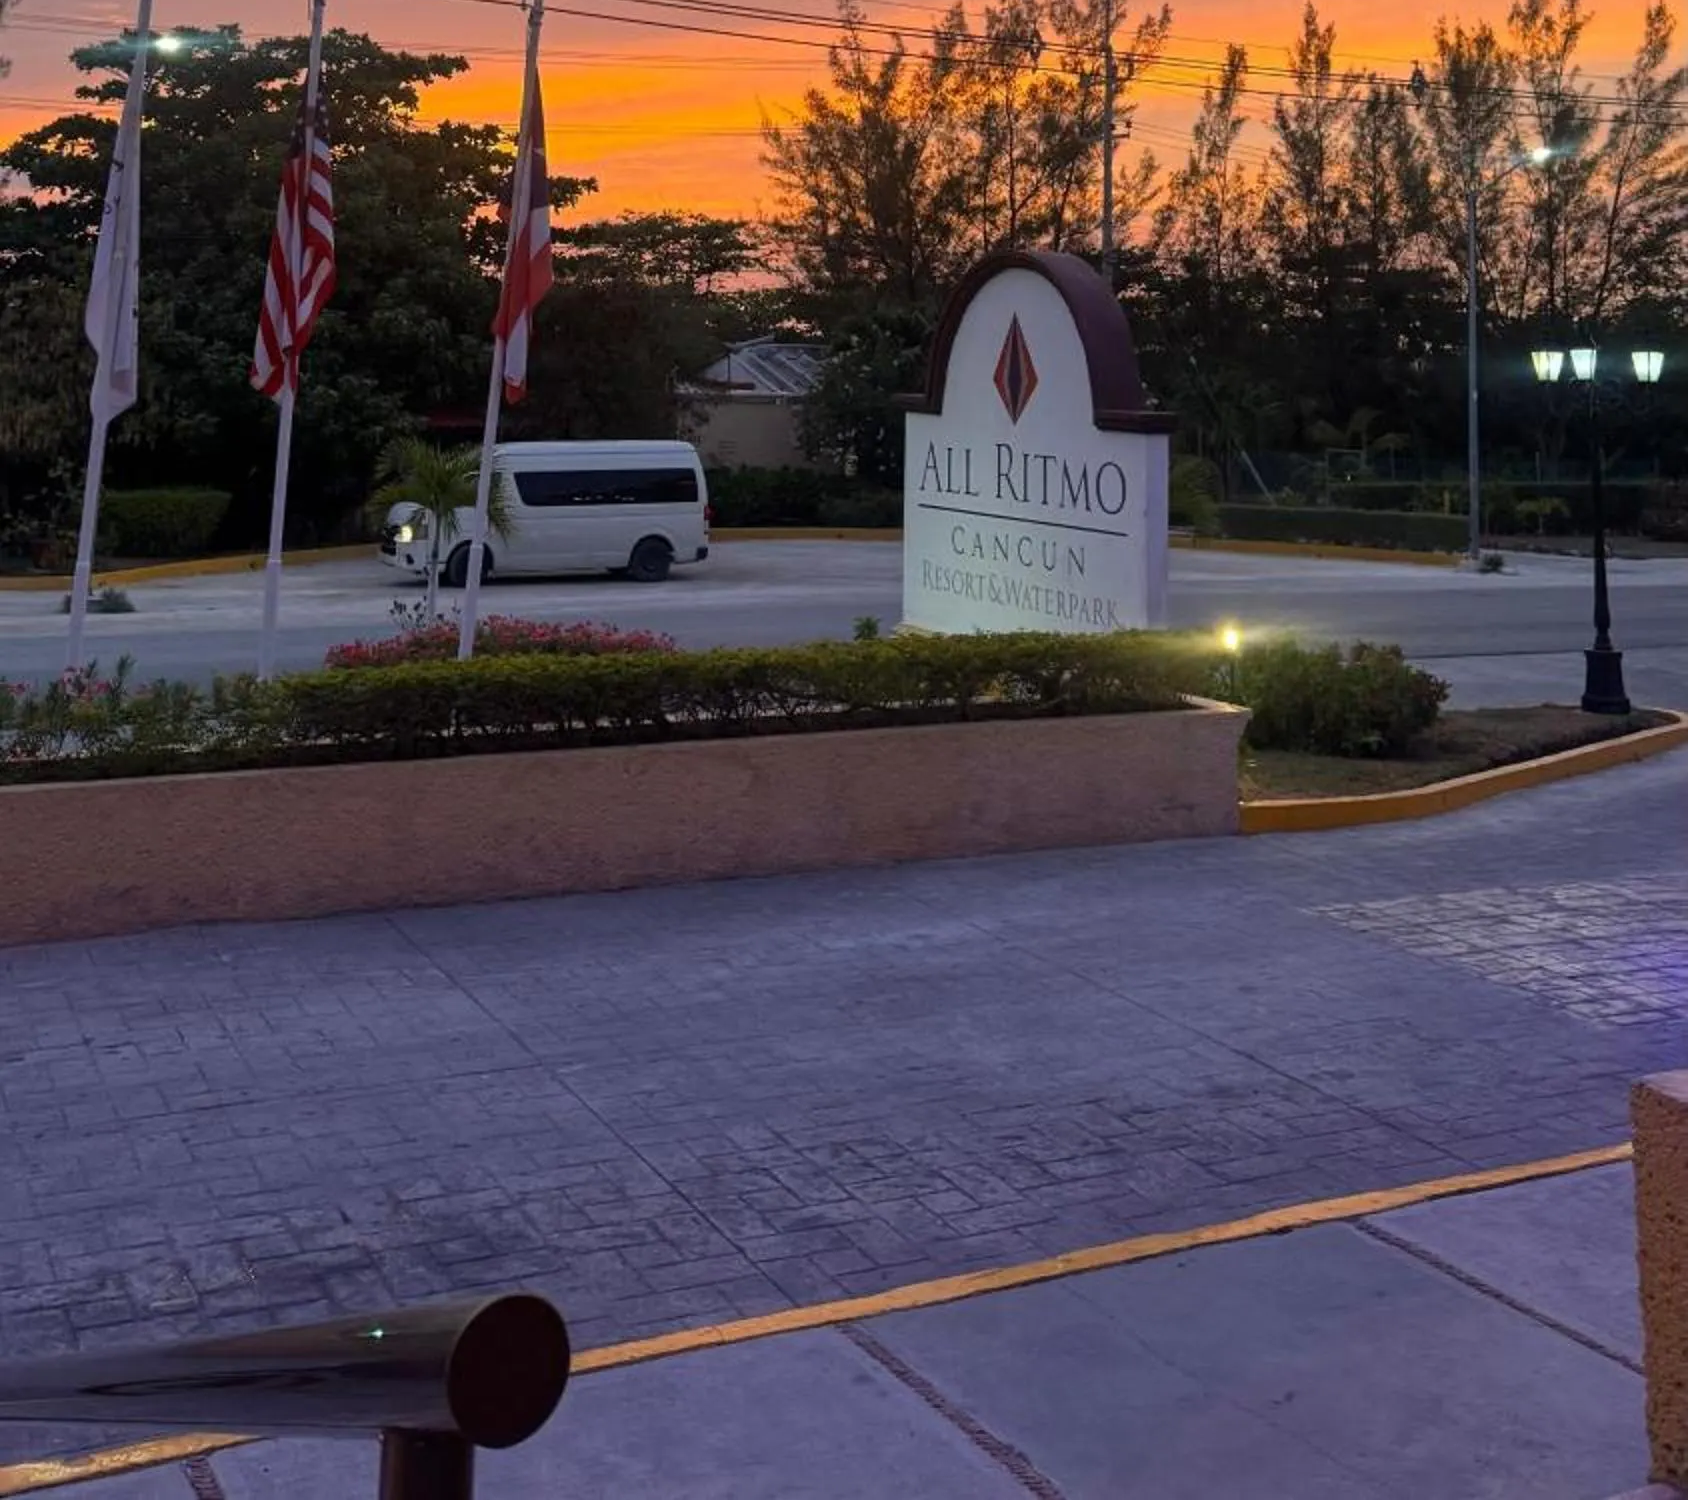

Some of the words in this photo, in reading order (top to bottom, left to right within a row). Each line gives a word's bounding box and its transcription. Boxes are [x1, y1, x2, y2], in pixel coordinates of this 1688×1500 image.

[918, 440, 980, 497] ALL
[994, 442, 1127, 515] RITMO
[951, 525, 1085, 577] CANCUN
